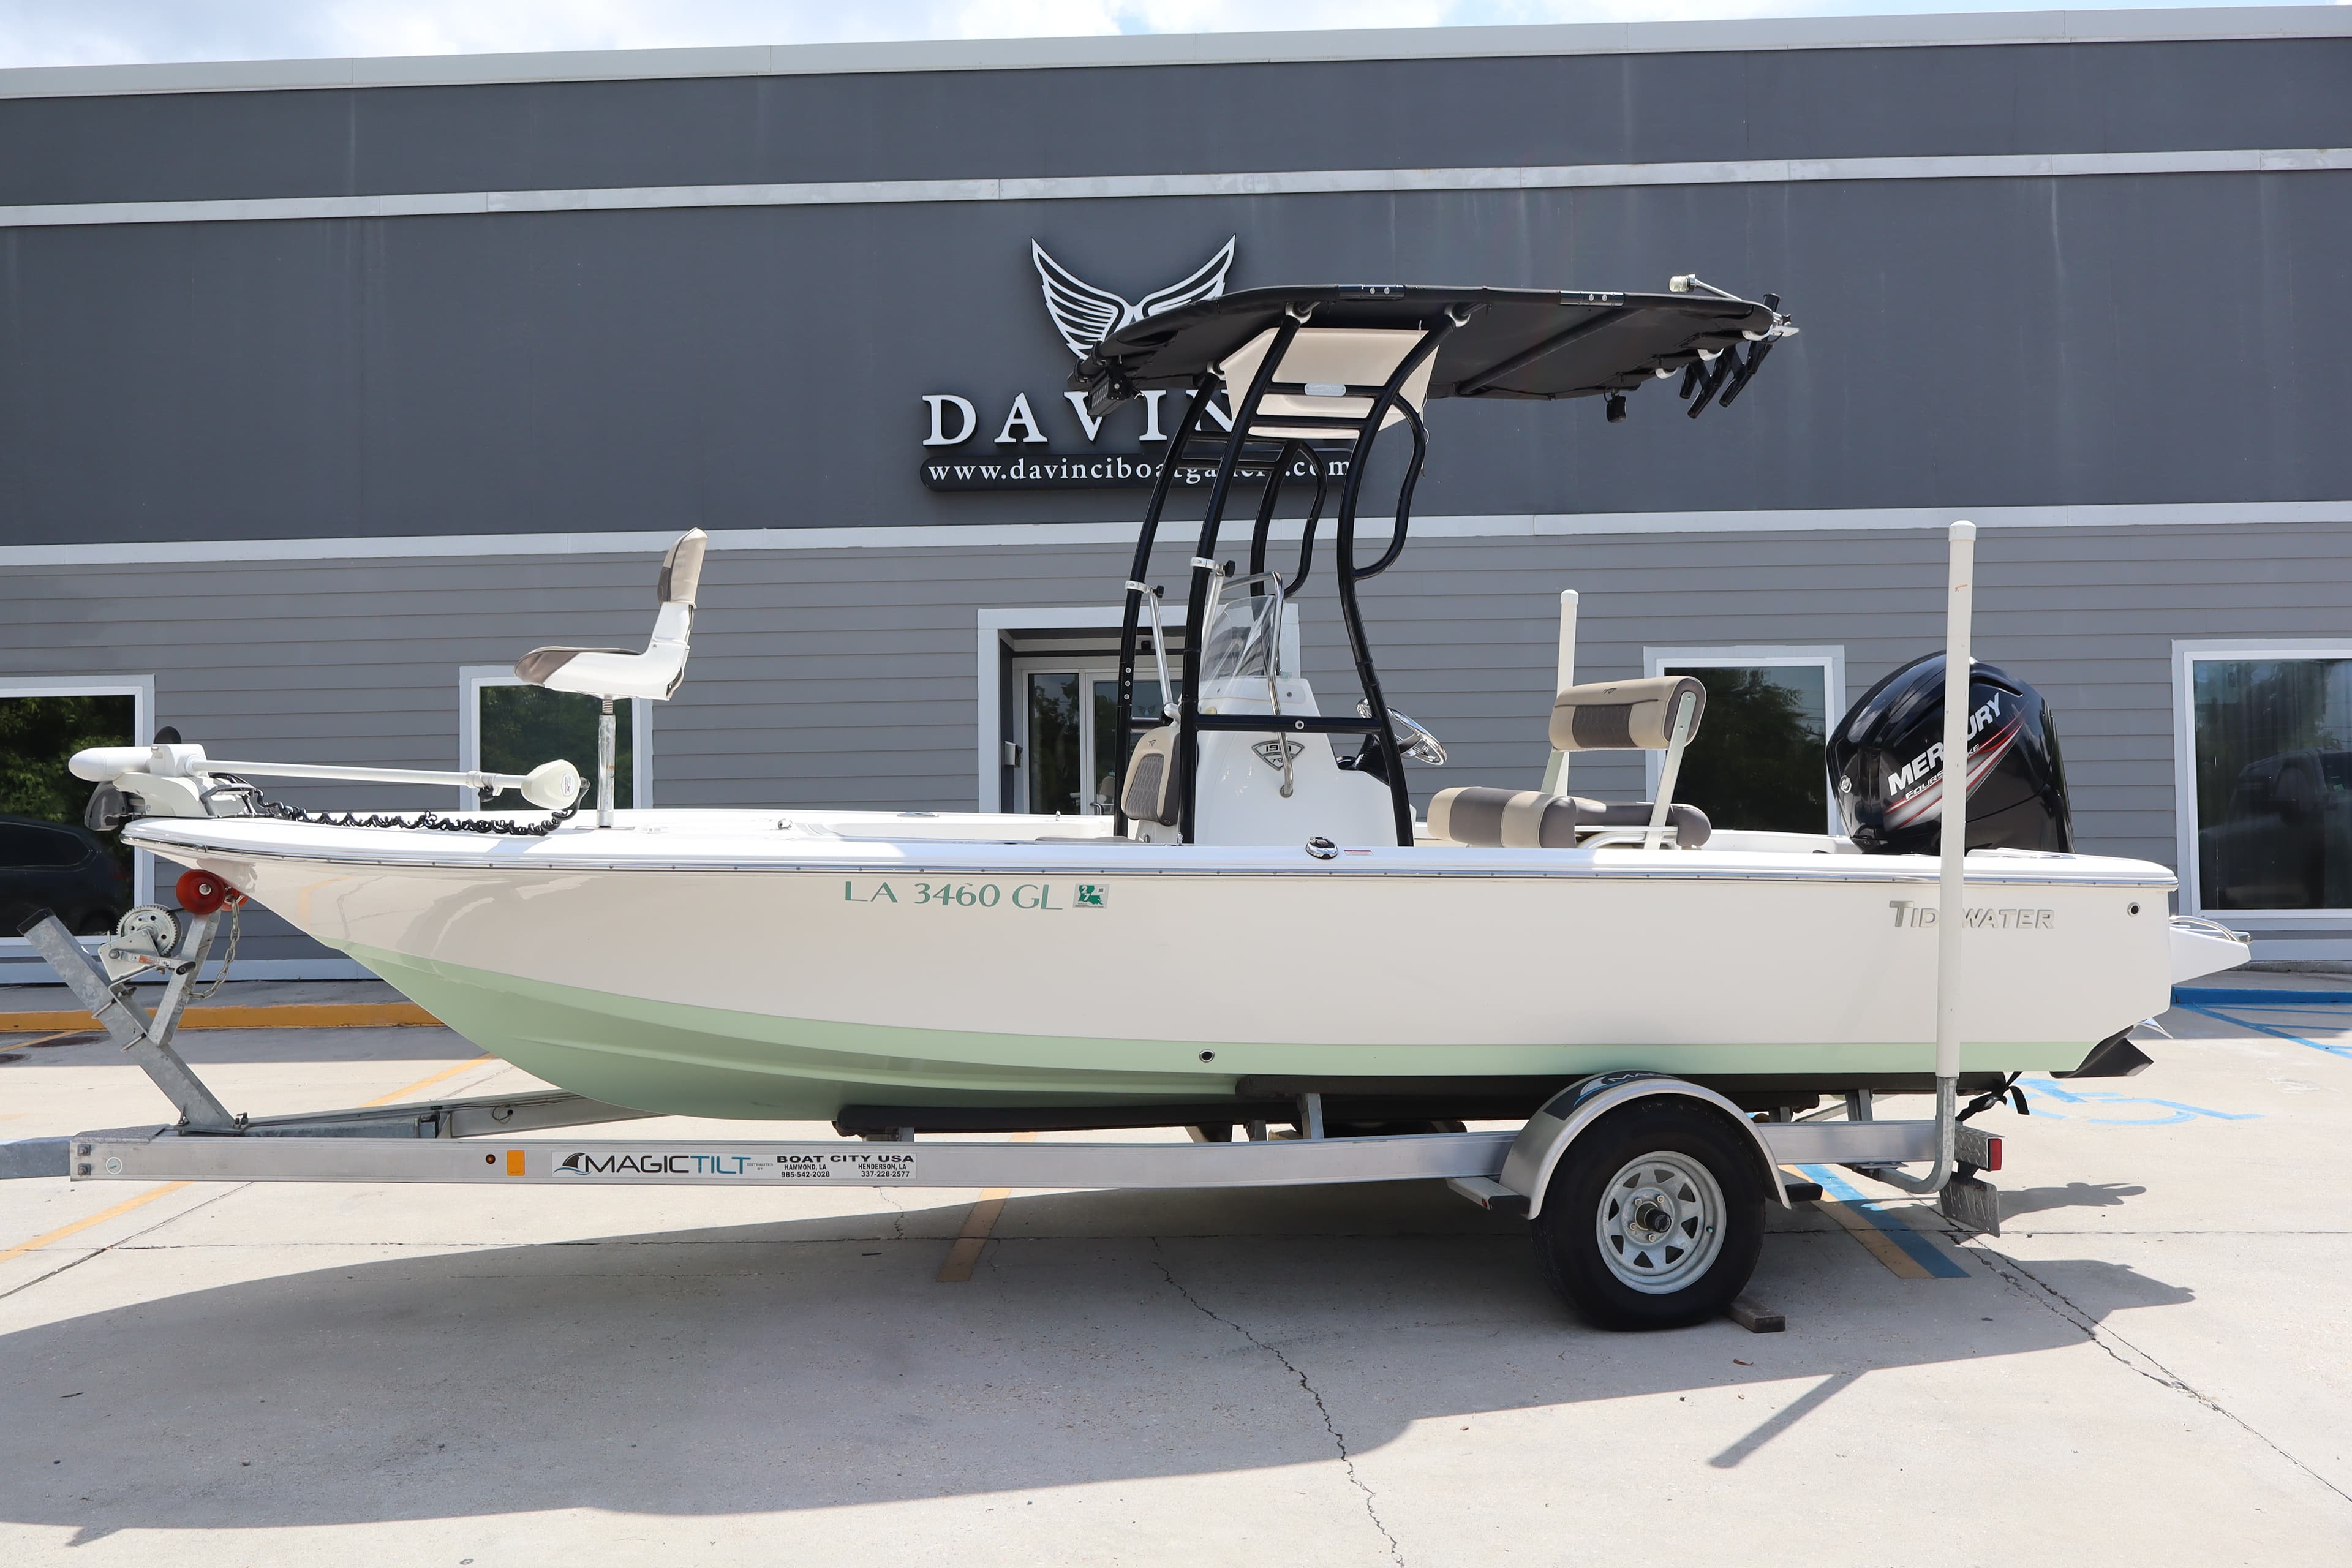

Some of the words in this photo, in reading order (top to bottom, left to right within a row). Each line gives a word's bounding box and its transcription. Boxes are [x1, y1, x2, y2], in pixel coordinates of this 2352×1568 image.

[922, 389, 1234, 446] DAVIN
[1888, 692, 2000, 796] MERURY
[1905, 743, 1980, 800] FOURSKE
[845, 881, 898, 903] LA
[914, 883, 1000, 908] 3460
[1012, 884, 1063, 910] GL
[1889, 900, 2054, 929] TIDWATER
